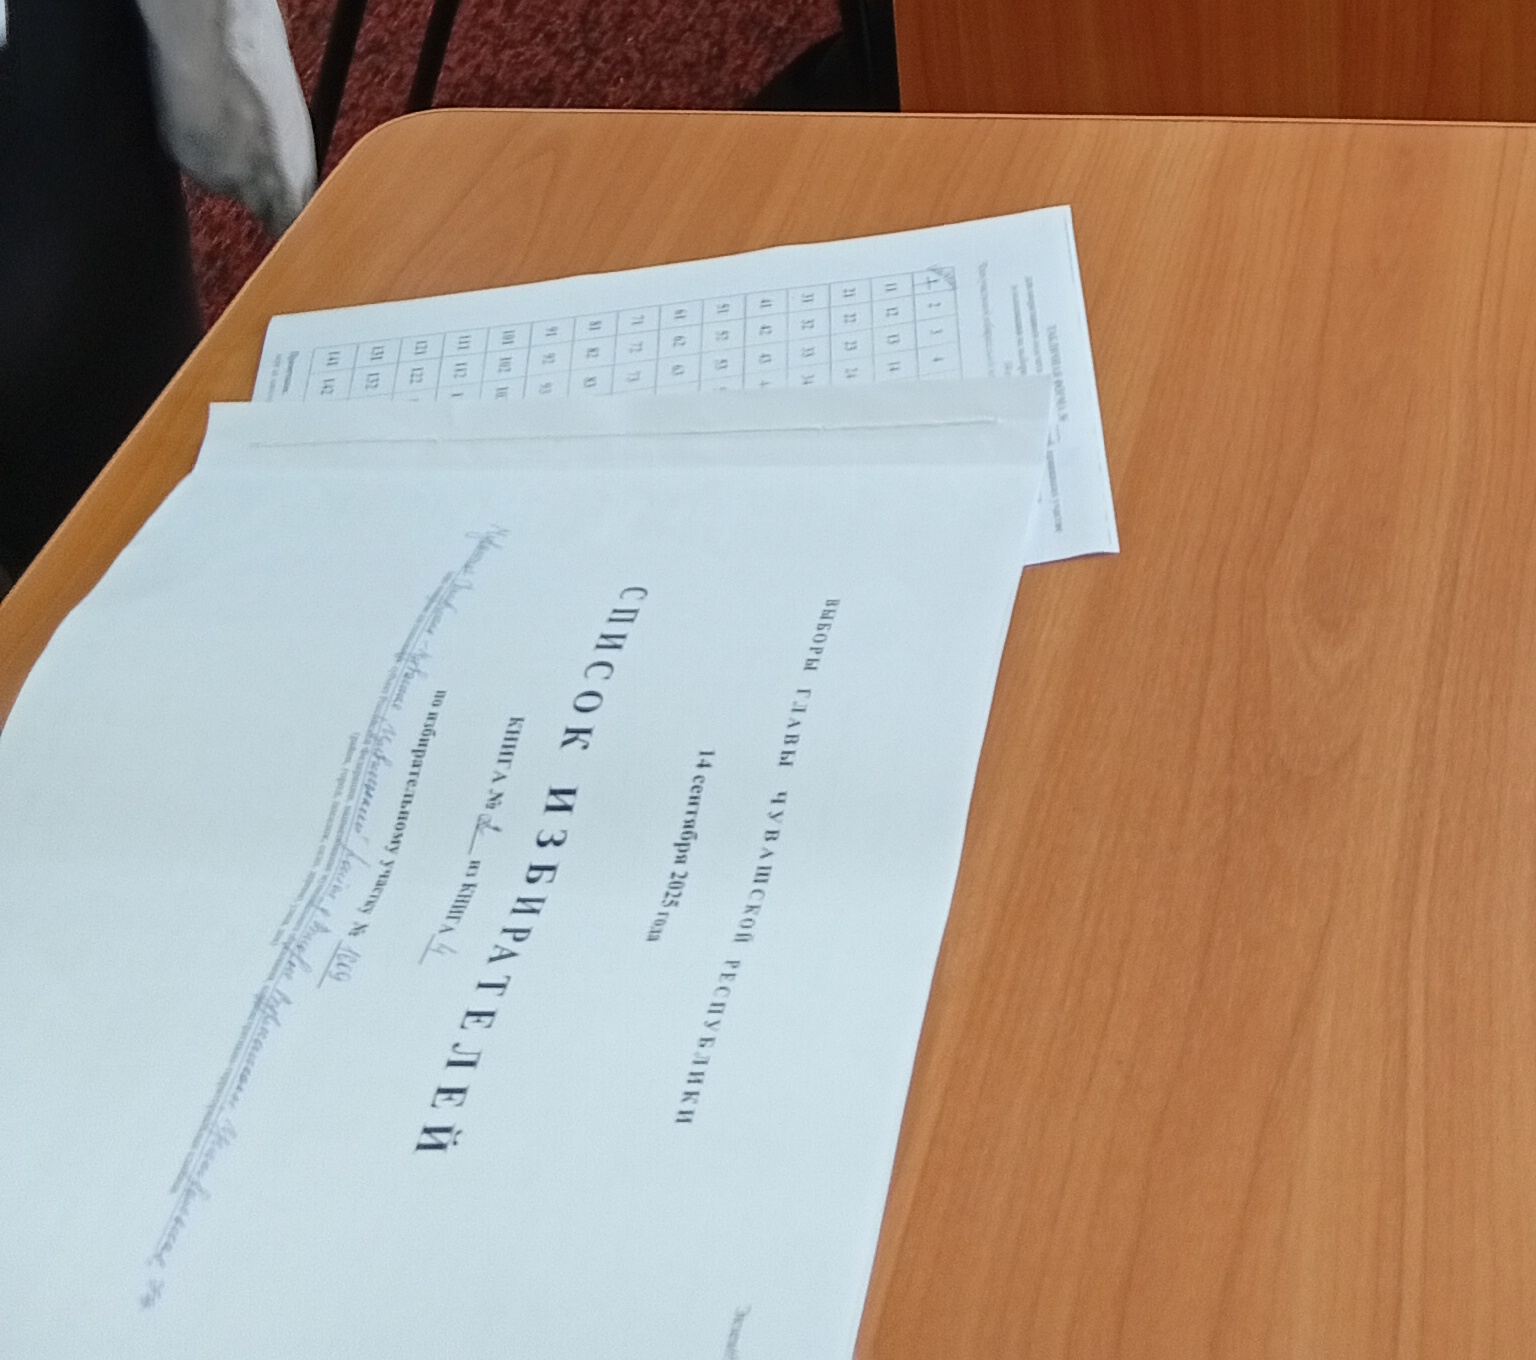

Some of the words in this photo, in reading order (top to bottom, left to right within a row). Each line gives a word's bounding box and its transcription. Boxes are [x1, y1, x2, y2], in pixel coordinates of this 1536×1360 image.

[803, 598, 841, 673] ВЫБОРЫ
[430, 689, 449, 708] по
[559, 585, 650, 752] СПИСОК
[490, 716, 526, 784] КНИГА
[695, 748, 717, 770] 14
[778, 688, 812, 767] ГЛАВЫ
[385, 710, 442, 855] избирательному
[484, 788, 506, 810] №
[672, 774, 707, 865] сентября
[357, 858, 396, 916] участку
[465, 860, 481, 877] из
[661, 869, 690, 909] 2025
[733, 791, 788, 945] ЧУВАШСКОЙ
[347, 921, 370, 937] №
[438, 883, 478, 934] КНИГА
[646, 910, 673, 942] года
[413, 784, 580, 1155] ИЗБИРАТЕЛЕЙ
[674, 959, 742, 1125] РЕСПУБЛИКИ
